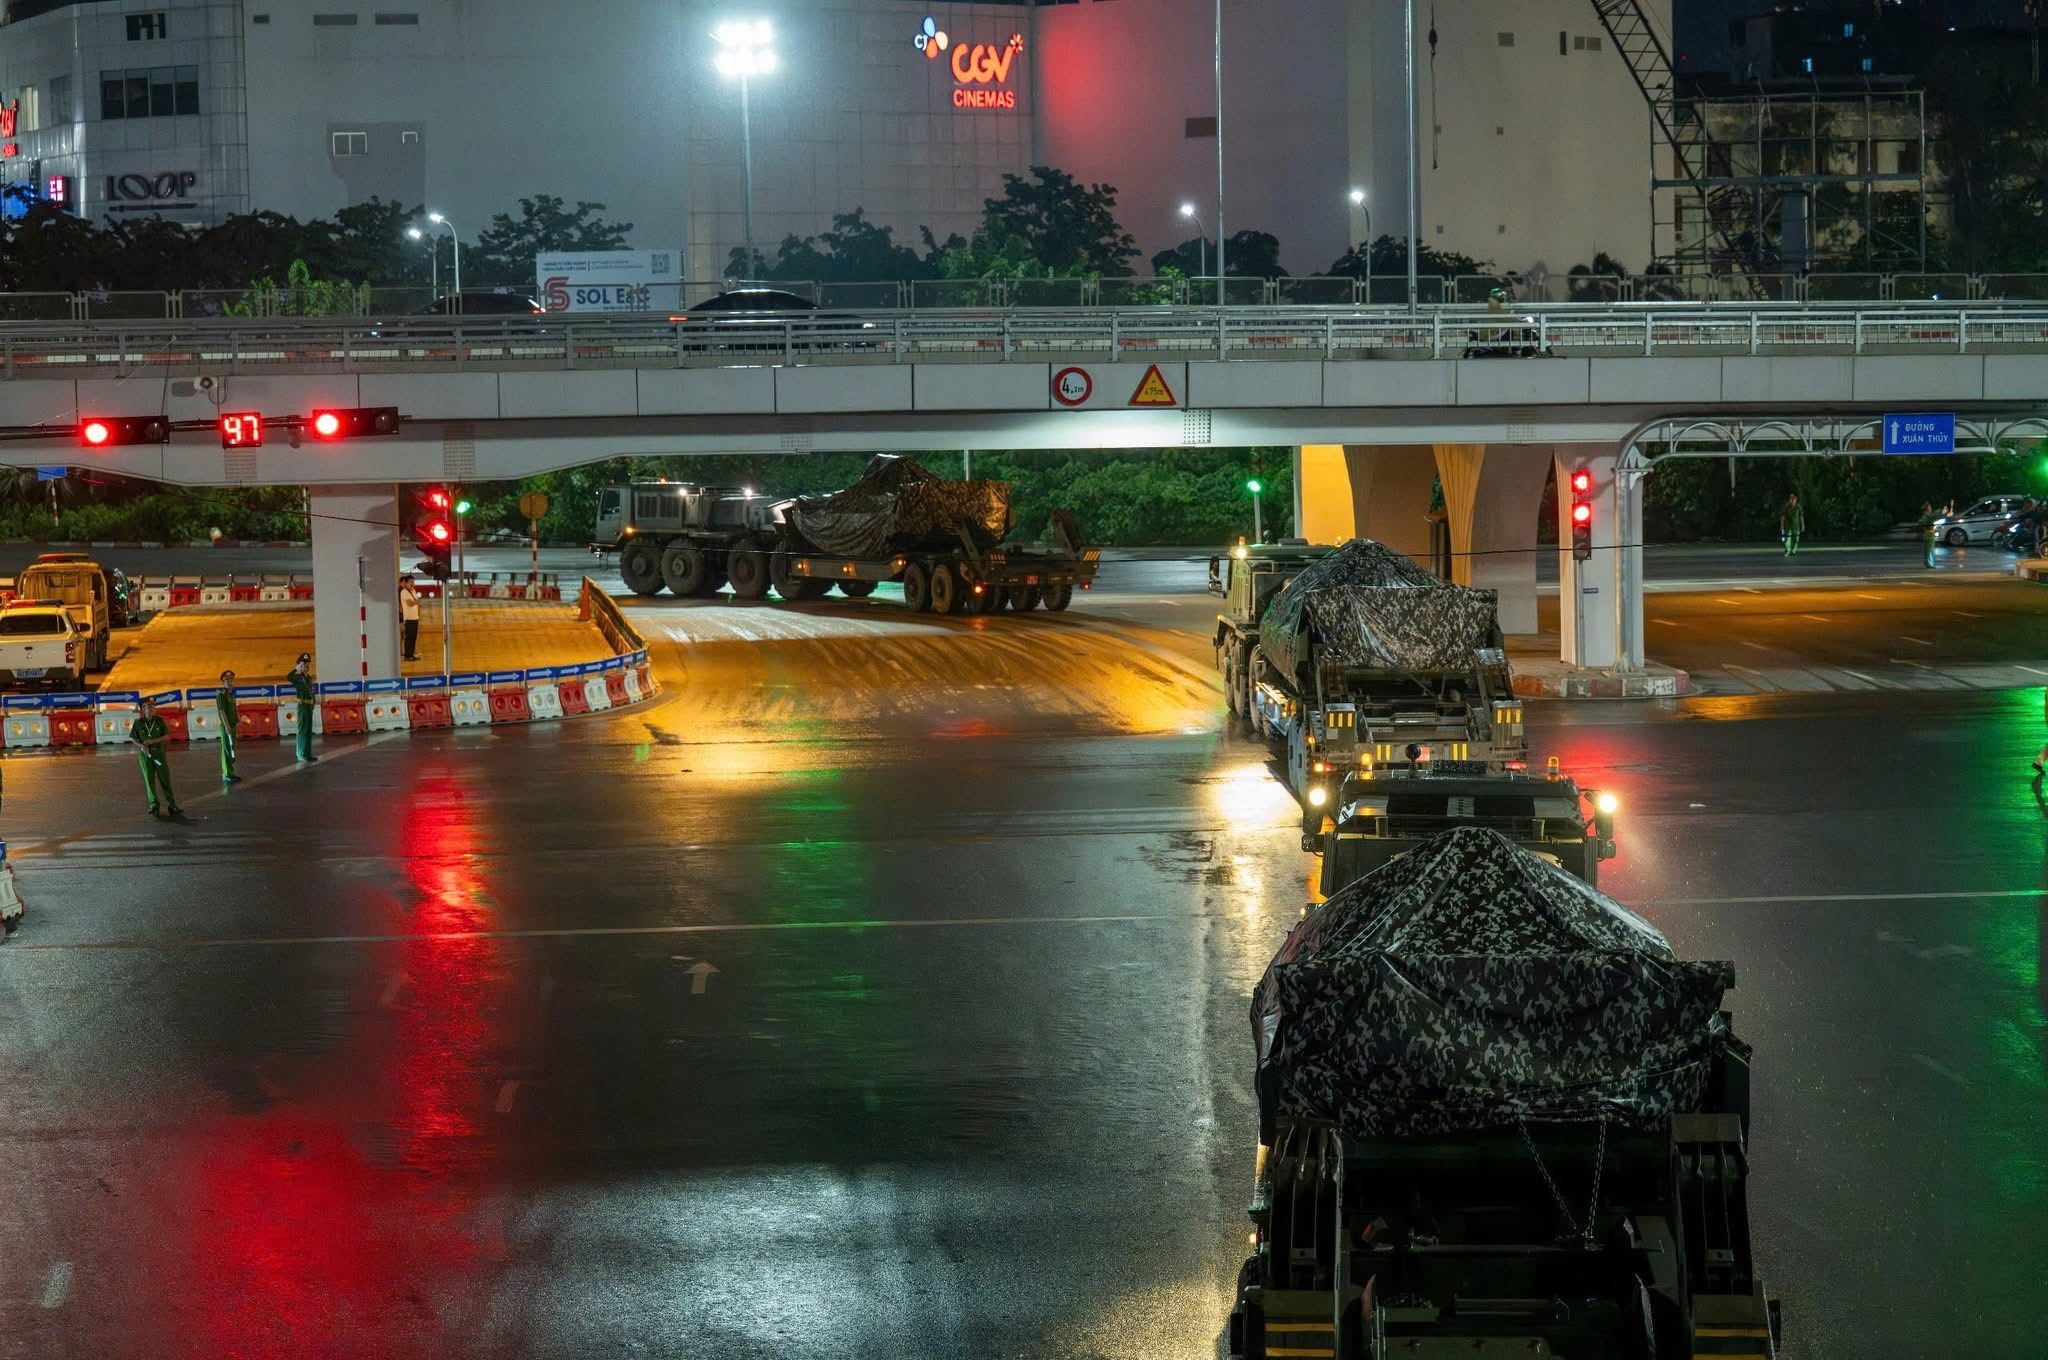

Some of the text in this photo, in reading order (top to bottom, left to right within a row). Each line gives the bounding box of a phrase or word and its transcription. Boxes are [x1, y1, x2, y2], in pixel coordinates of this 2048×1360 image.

[914, 34, 928, 51] CJ
[951, 43, 1015, 84] CGV
[953, 89, 1015, 108] CINEMAS
[106, 172, 196, 200] LOOP
[576, 288, 610, 305] SOL
[224, 415, 259, 445] 97
[1902, 433, 1924, 444] XUÂN
